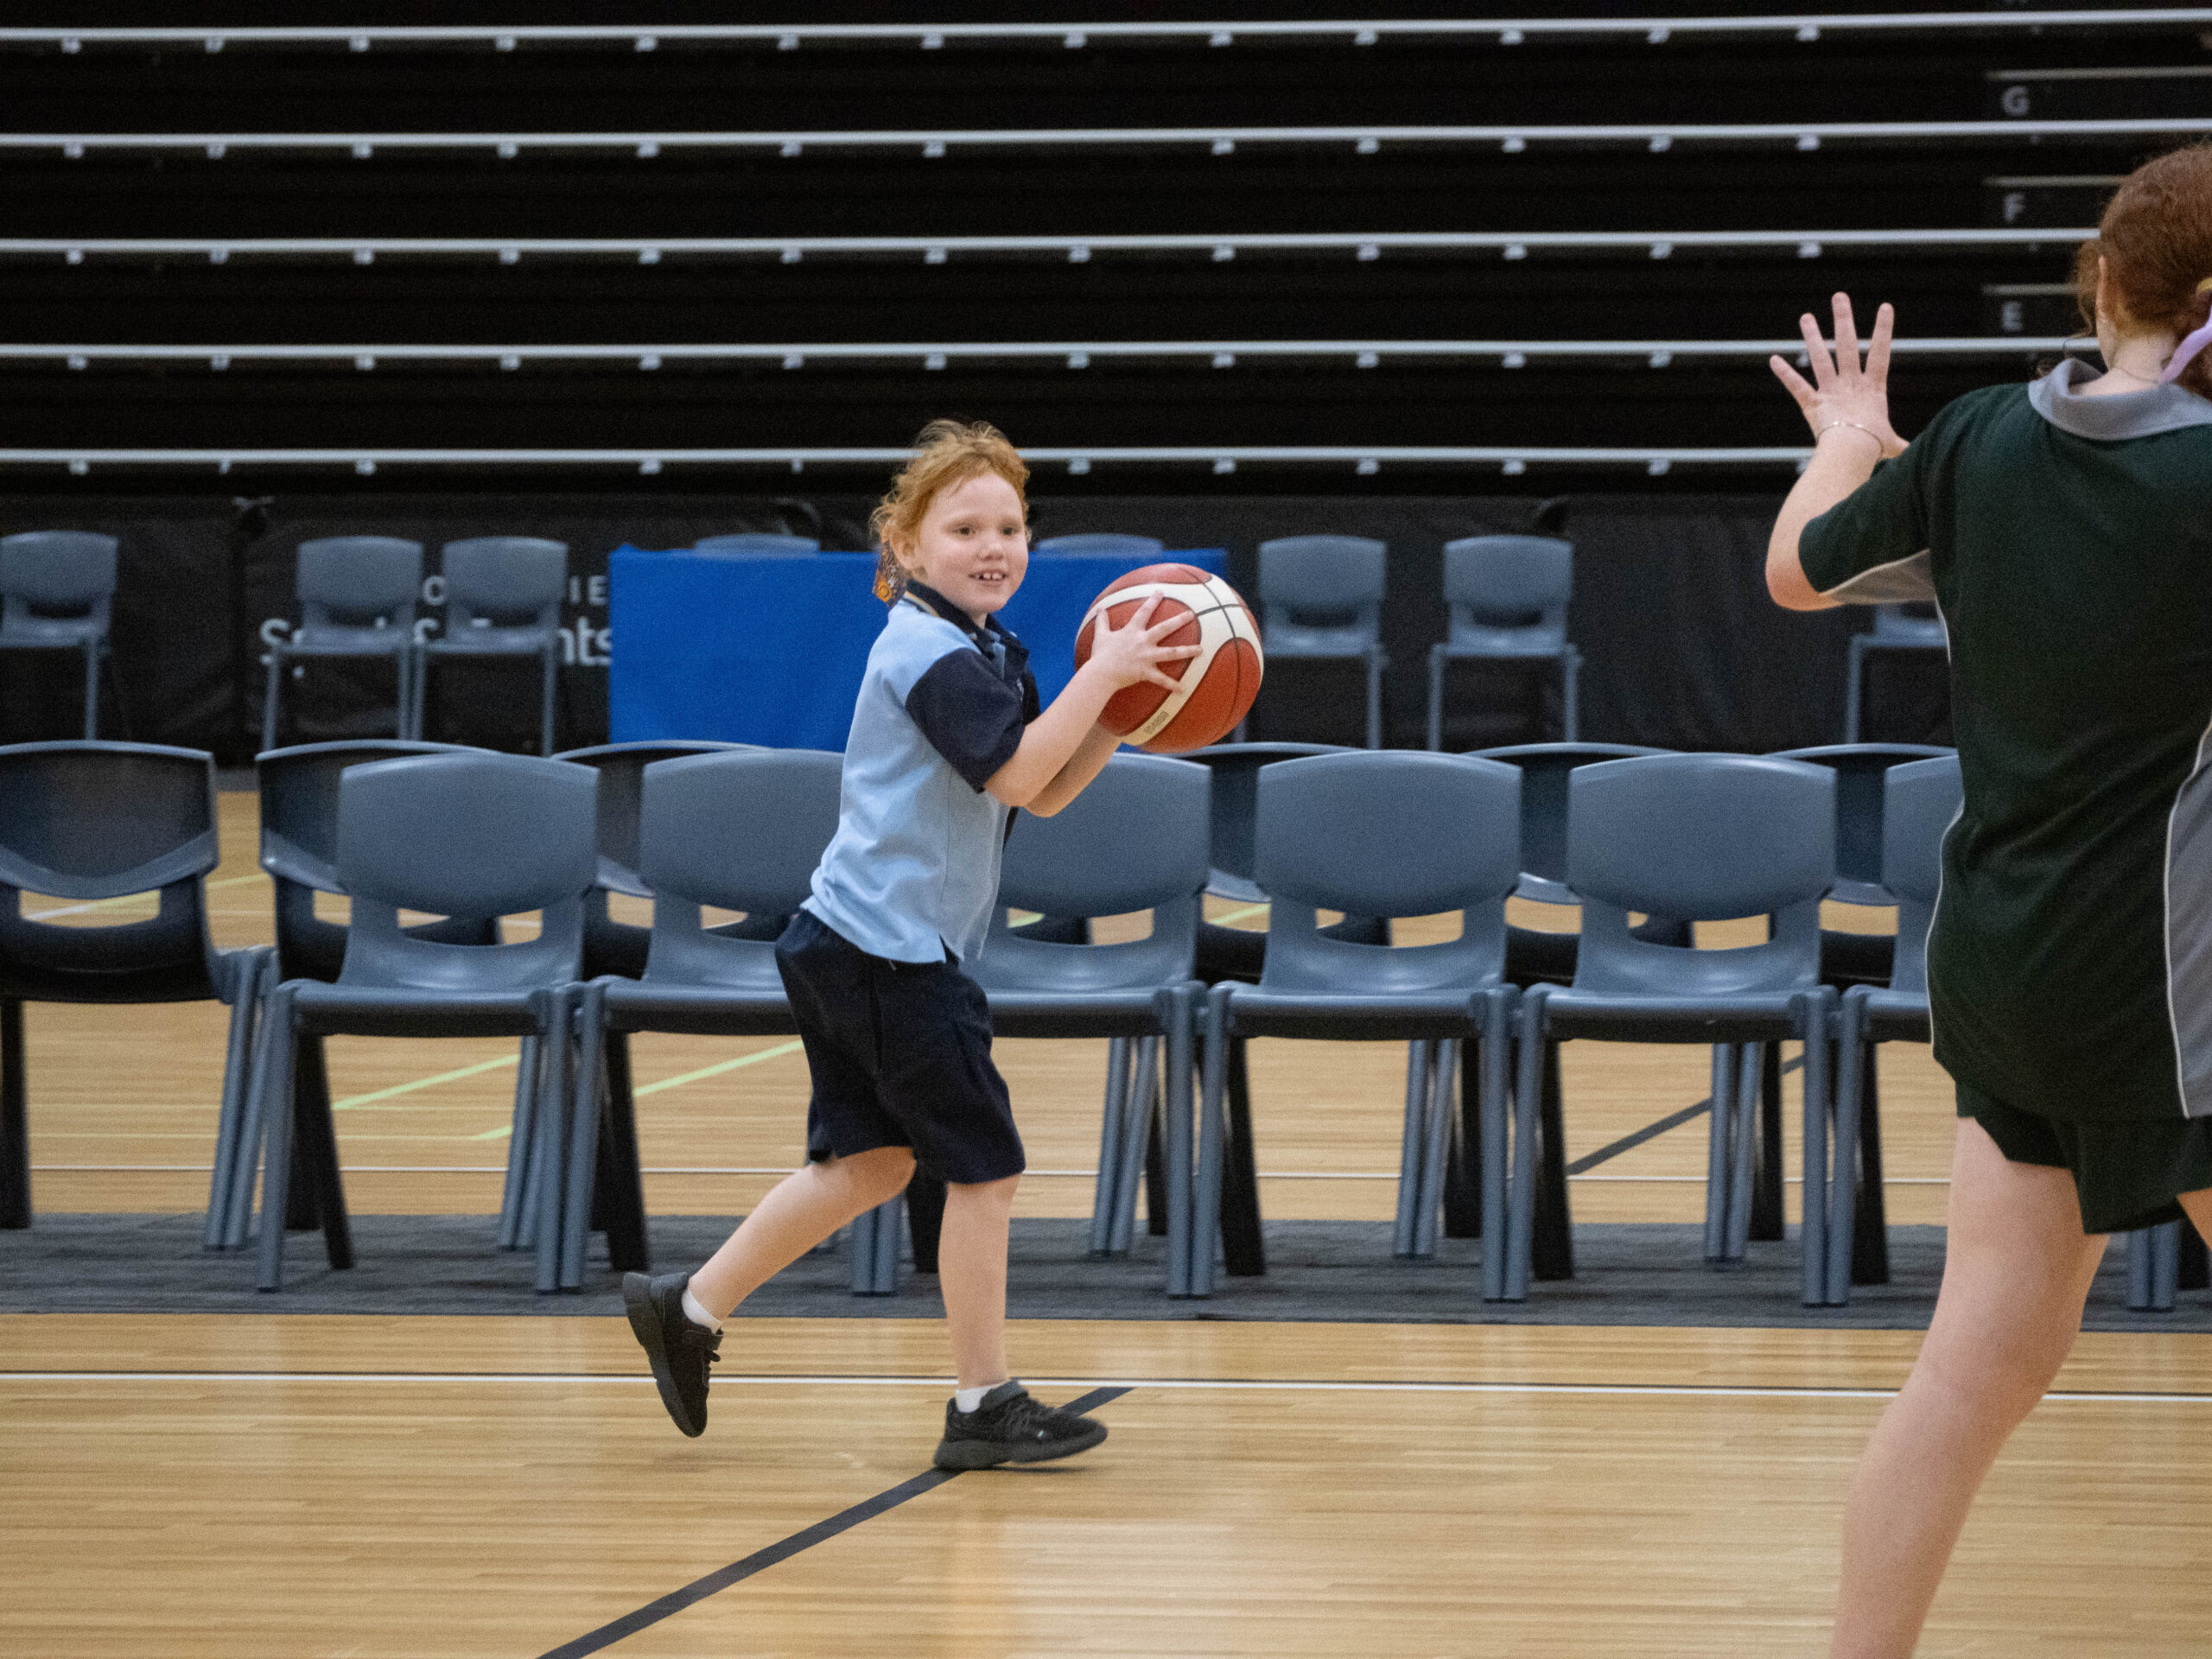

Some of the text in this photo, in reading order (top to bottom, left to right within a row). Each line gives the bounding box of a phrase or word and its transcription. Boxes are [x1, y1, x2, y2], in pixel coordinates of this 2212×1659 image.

[2000, 86, 2031, 116] G
[2003, 192, 2026, 224] F
[2001, 300, 2024, 332] E
